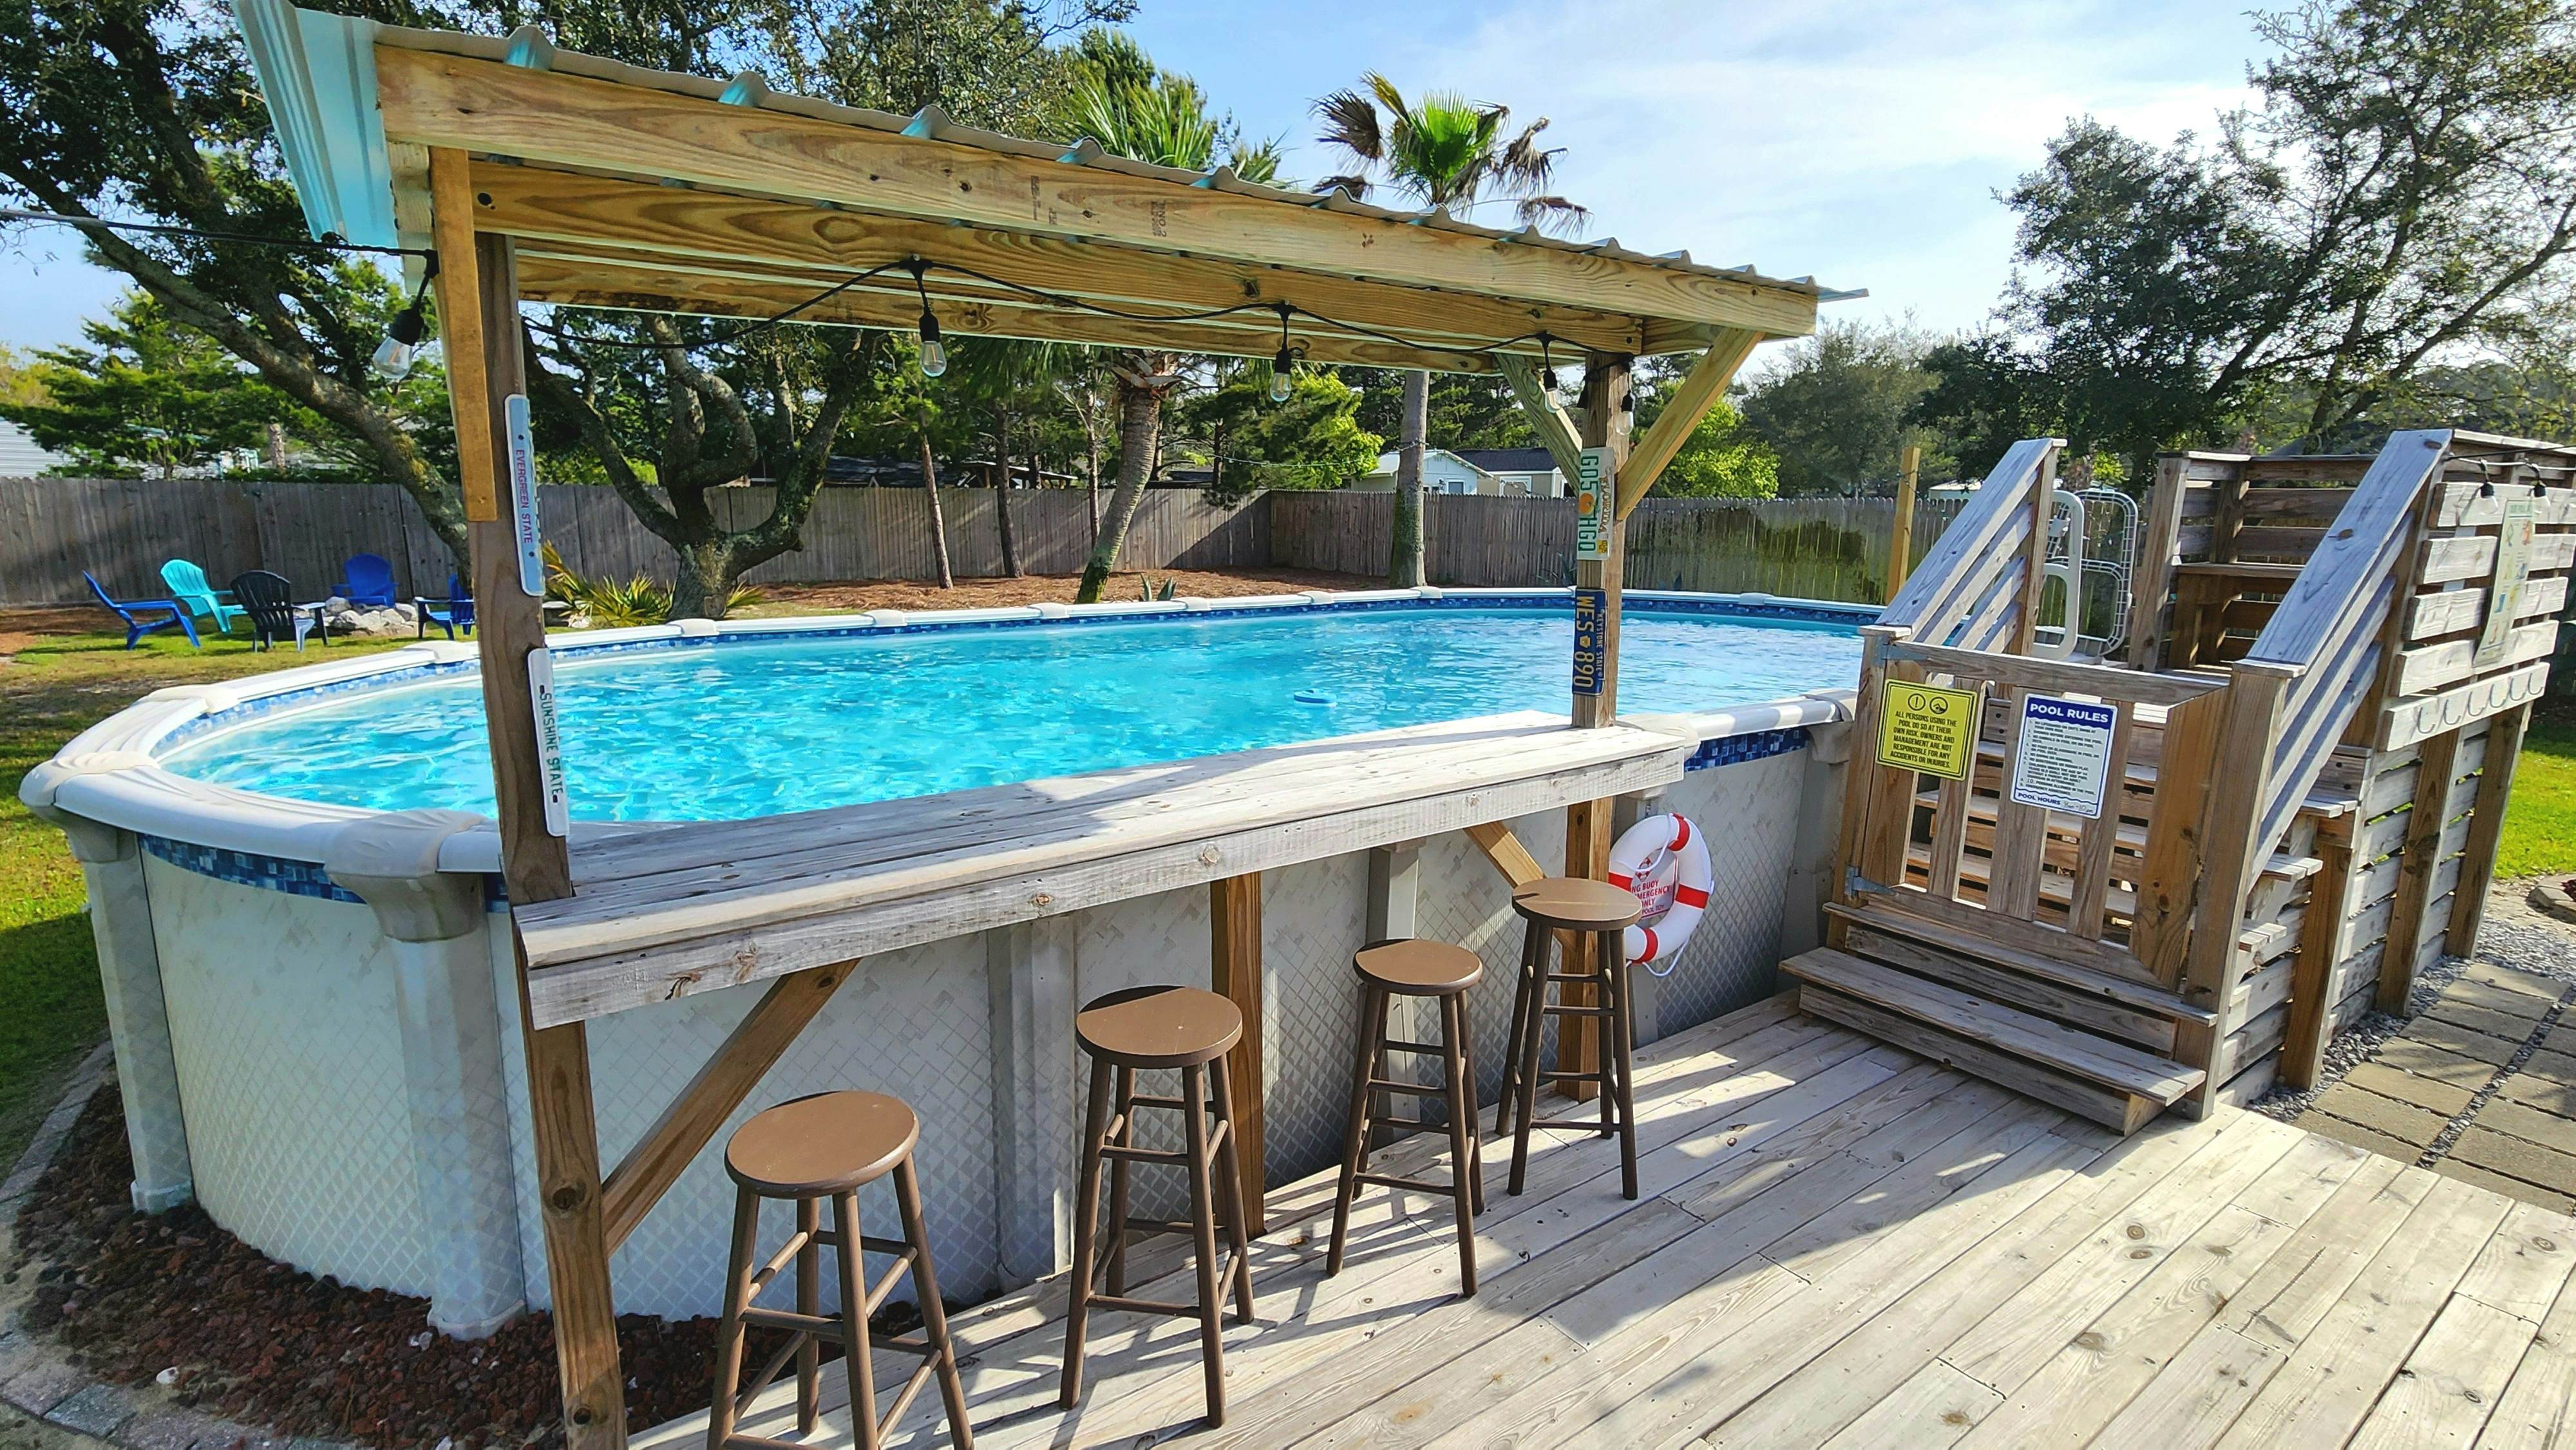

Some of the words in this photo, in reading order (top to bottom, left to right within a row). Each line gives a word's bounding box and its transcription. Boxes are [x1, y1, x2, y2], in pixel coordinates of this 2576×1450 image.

[516, 449, 529, 509] EVERGREEN
[1598, 476, 1612, 534] FLORIDA
[521, 513, 533, 544] STATE
[1576, 596, 1595, 632] WES
[1596, 613, 1604, 648] KEYSTONE
[1573, 651, 1595, 688] 890
[1595, 652, 1604, 672] STATE
[540, 692, 559, 752] SUNSHINE
[1906, 712, 1929, 722] PERSONS
[1929, 716, 1946, 724] USING
[2030, 703, 2064, 716] POOL
[2067, 708, 2108, 722] RULES
[1920, 731, 1942, 741] OWNERS
[1935, 726, 1951, 734] THEIR
[1893, 735, 1929, 747] MANAGEMENT
[1893, 743, 1927, 755] RESPONSIBLE
[1890, 750, 1917, 762] ACCIDENTS
[547, 757, 564, 794] STATE
[2037, 796, 2061, 805] HOURS
[1634, 884, 1671, 900] MERGENCY
[1642, 880, 1659, 890] BUOY
